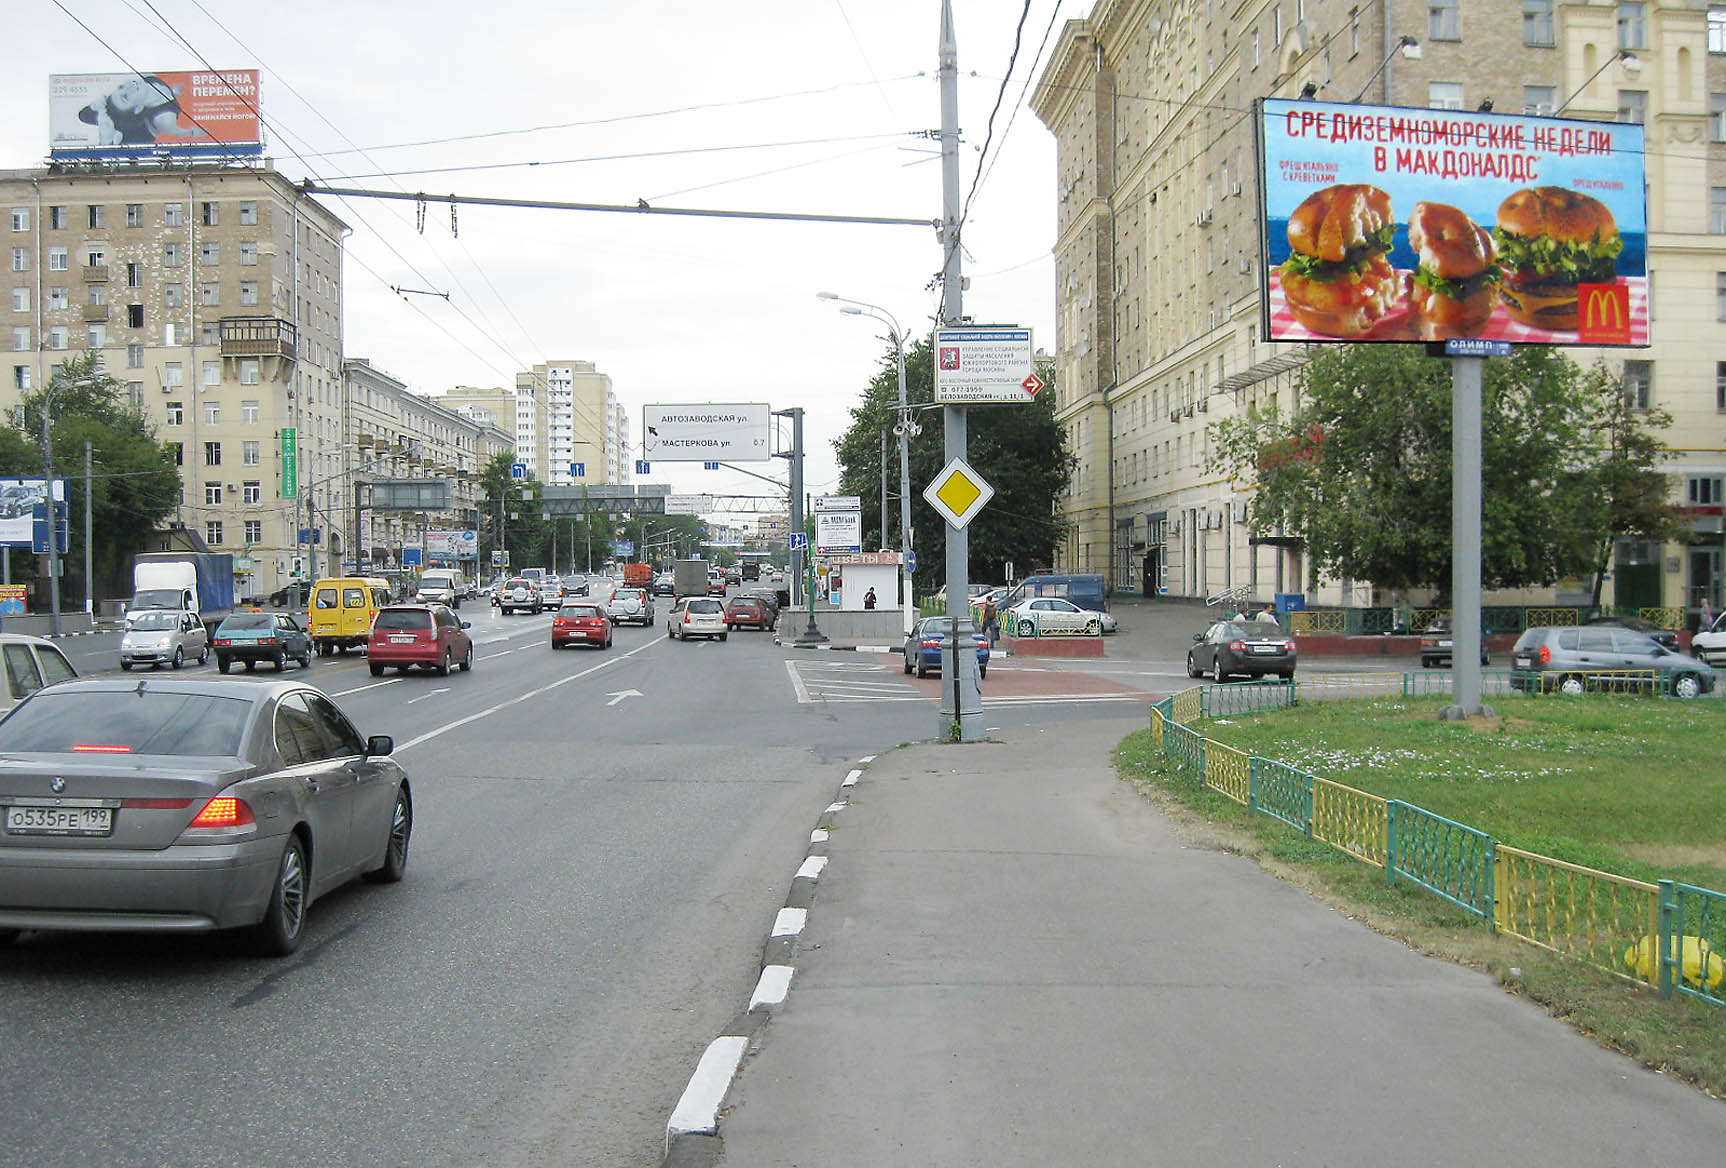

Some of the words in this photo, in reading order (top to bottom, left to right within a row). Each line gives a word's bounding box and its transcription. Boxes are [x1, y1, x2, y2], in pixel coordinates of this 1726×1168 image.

[192, 73, 252, 85] ВРЕМЕНА
[192, 85, 256, 97] ПЕРЕМЕН?
[1286, 110, 1526, 151] СРЕДИЗЕМНОМОРСКИЕ
[1533, 126, 1612, 158] НЕДЕЛИ
[1374, 145, 1388, 173] В
[1396, 147, 1540, 184] МАКДОНАЛДС
[1449, 339, 1493, 350] ОЛИМП
[661, 414, 735, 424] АВТОЗАВОДСКАЯ
[662, 439, 719, 447] МАСТЕРКОВА
[13, 808, 79, 828] О535РЕ
[82, 809, 108, 824] 199
